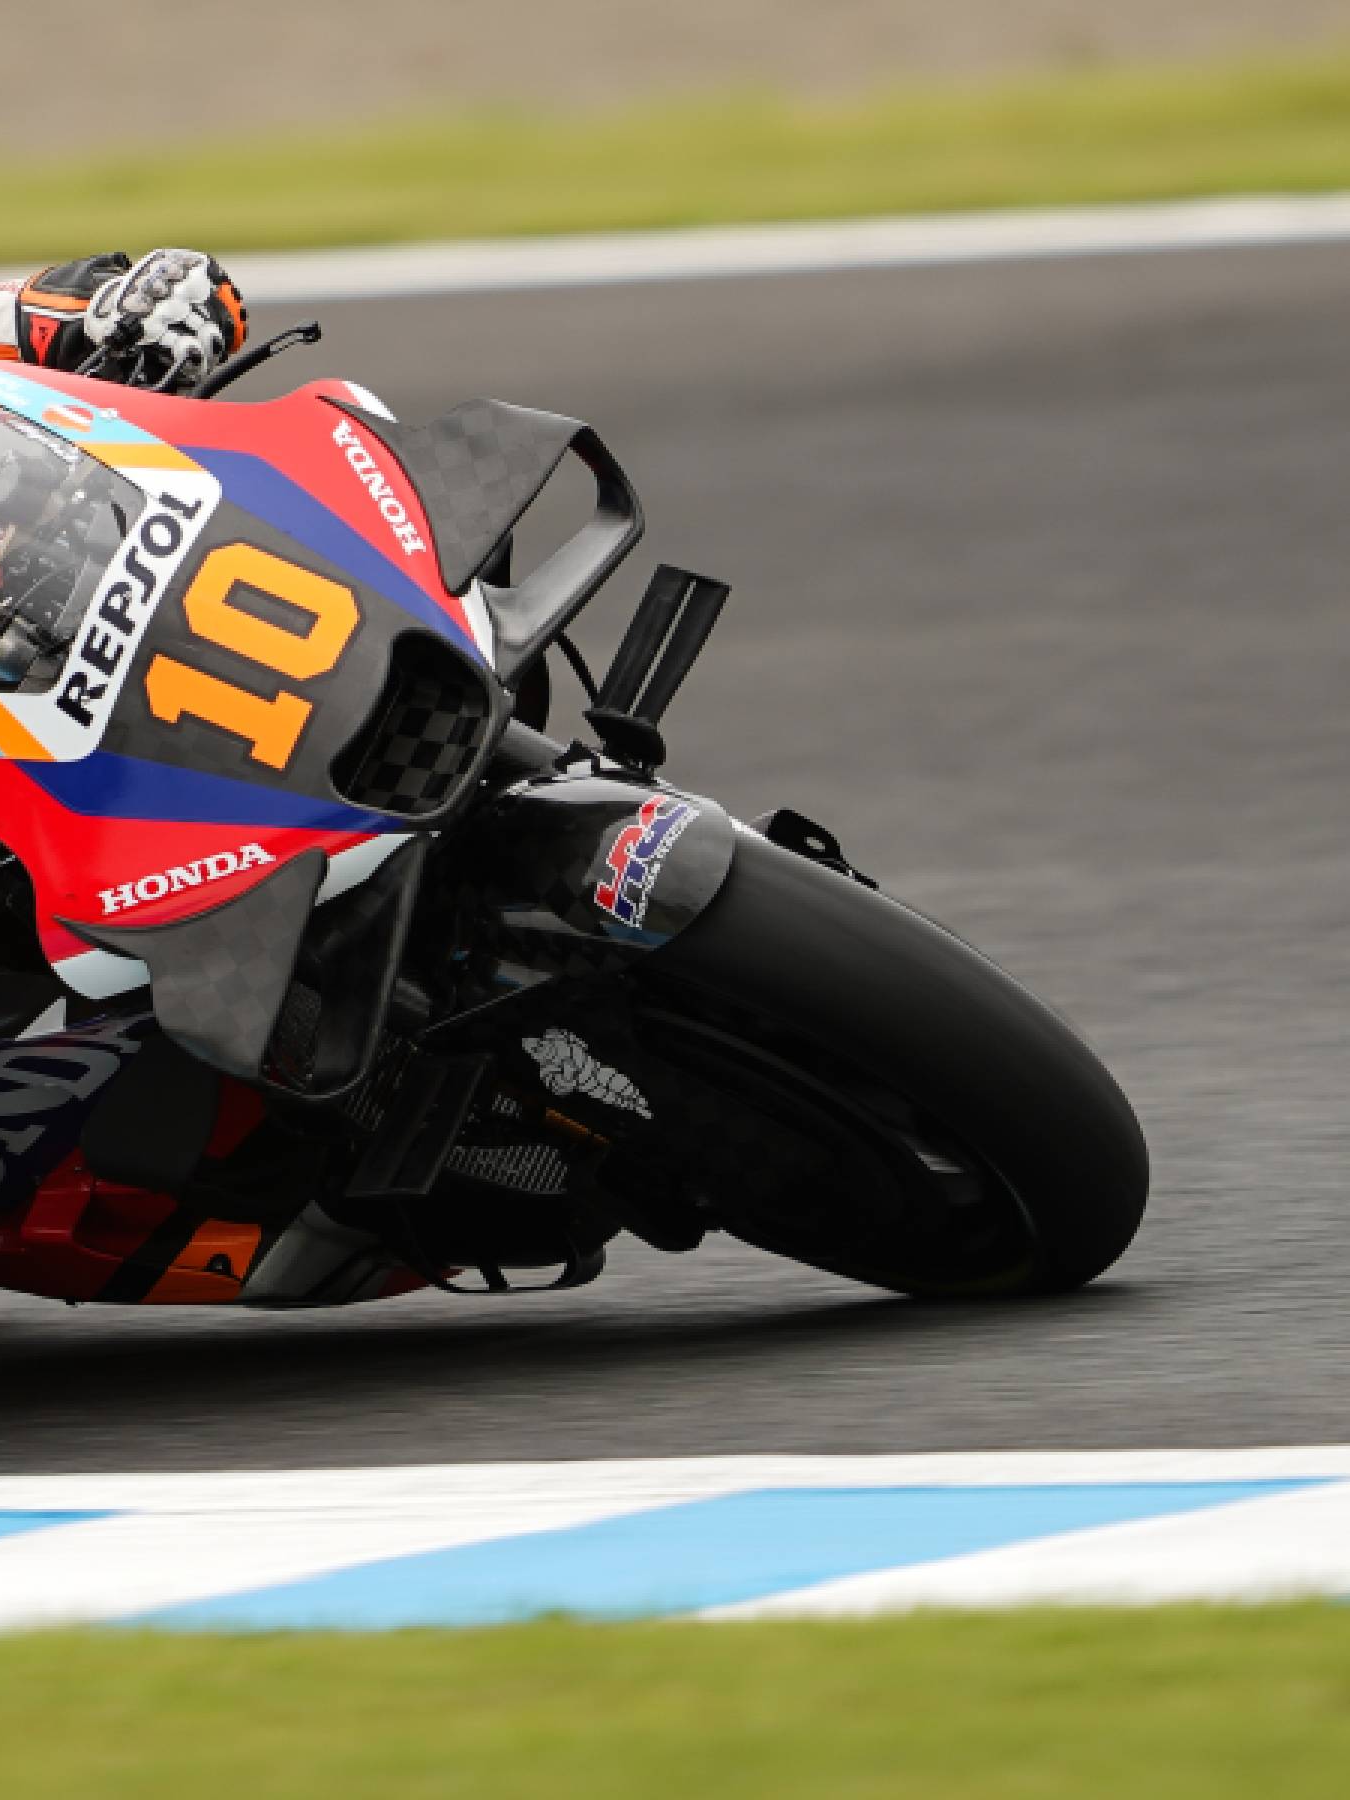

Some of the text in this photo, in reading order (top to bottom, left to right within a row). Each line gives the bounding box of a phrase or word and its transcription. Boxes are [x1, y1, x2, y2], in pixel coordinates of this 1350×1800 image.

[330, 419, 427, 556] HONDA
[55, 491, 203, 728] REPSOL
[144, 542, 361, 772] 10
[97, 842, 276, 915] HONDA
